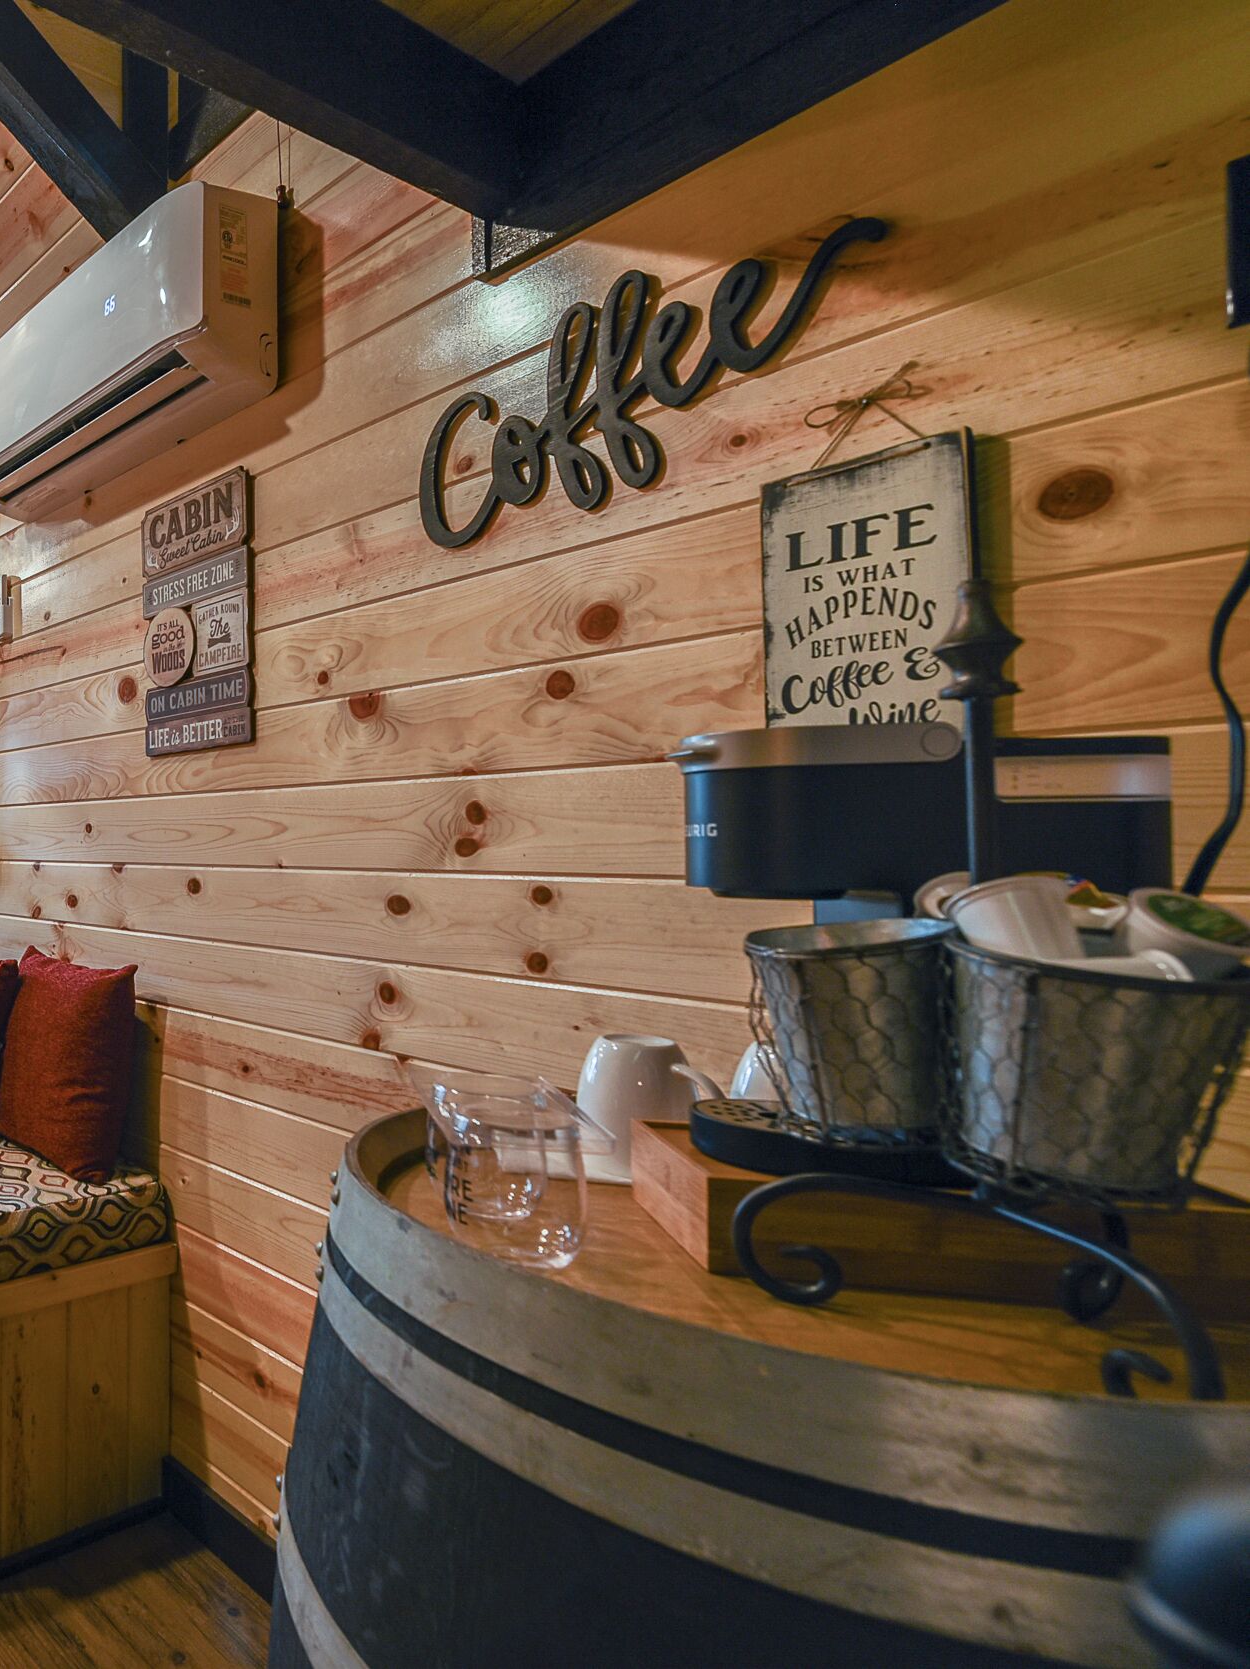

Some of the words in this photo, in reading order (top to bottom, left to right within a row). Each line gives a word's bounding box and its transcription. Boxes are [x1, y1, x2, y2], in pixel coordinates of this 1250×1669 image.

[104, 294, 116, 316] 66
[419, 217, 885, 548] Coffee
[150, 482, 233, 549] CABIN
[159, 541, 190, 569] Sweet
[190, 529, 224, 553] Cabin
[785, 503, 938, 572] LIFE
[152, 578, 185, 606] STRESS
[187, 570, 209, 594] FREE
[211, 560, 235, 586] ZONE
[804, 575, 824, 593] IS
[837, 558, 916, 586] WHAT
[157, 621, 168, 633] IT'S
[169, 619, 180, 630] ALL
[198, 606, 219, 624] GATHER
[220, 603, 240, 614] ROUND
[210, 617, 231, 637] The
[785, 586, 937, 650] HAPPENDS
[151, 625, 185, 650] good
[811, 628, 908, 659] BETWEEN
[151, 649, 186, 675] WOODS
[198, 643, 242, 668] CAMPFIRE
[150, 695, 166, 714] ON
[170, 686, 206, 710] CABIN
[210, 678, 243, 702] TIME
[782, 660, 895, 715] Coffee
[903, 646, 941, 681] &
[849, 698, 941, 726] Wine
[149, 727, 170, 749] LIFE
[171, 729, 180, 746] is
[182, 718, 223, 744] BETTER
[223, 723, 246, 738] CABIN
